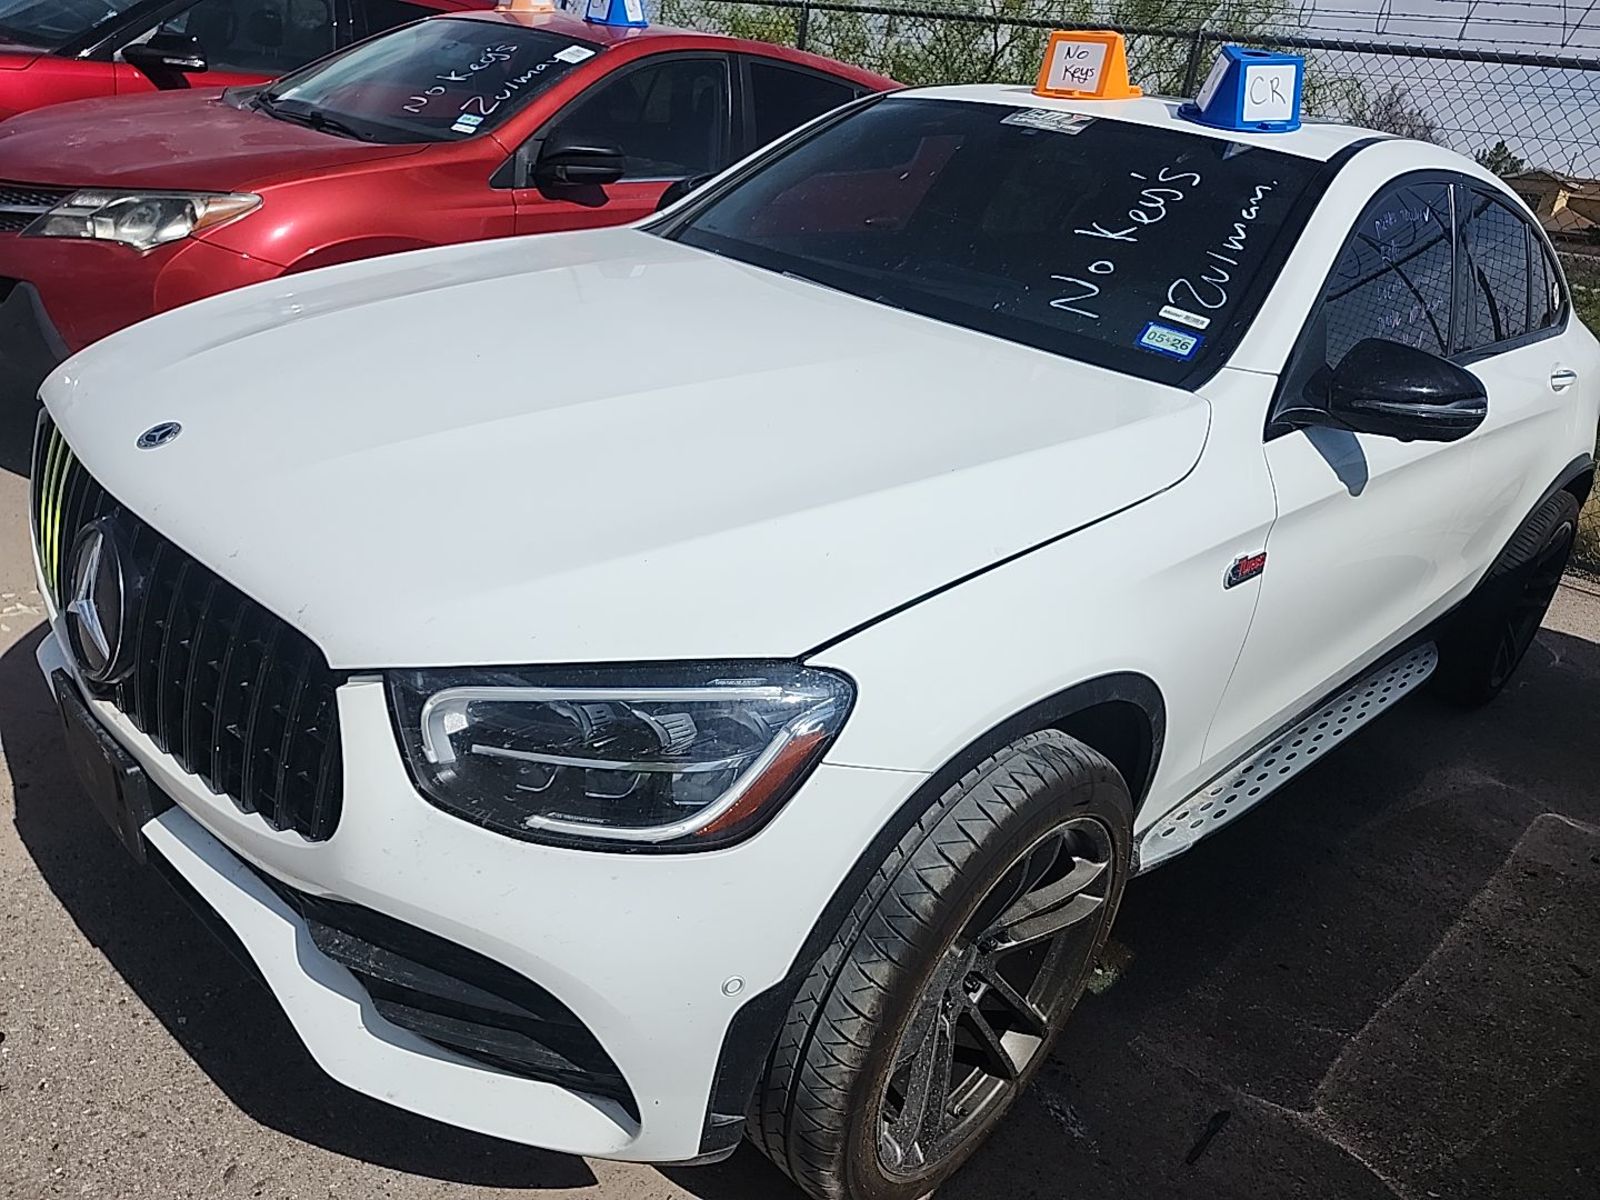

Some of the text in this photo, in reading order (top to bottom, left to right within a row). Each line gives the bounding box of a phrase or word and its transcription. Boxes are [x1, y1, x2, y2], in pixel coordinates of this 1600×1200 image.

[1064, 45, 1090, 60] No
[1062, 64, 1096, 84] Keys
[402, 86, 446, 113] No
[1249, 75, 1287, 105] CR
[1049, 260, 1115, 319] No
